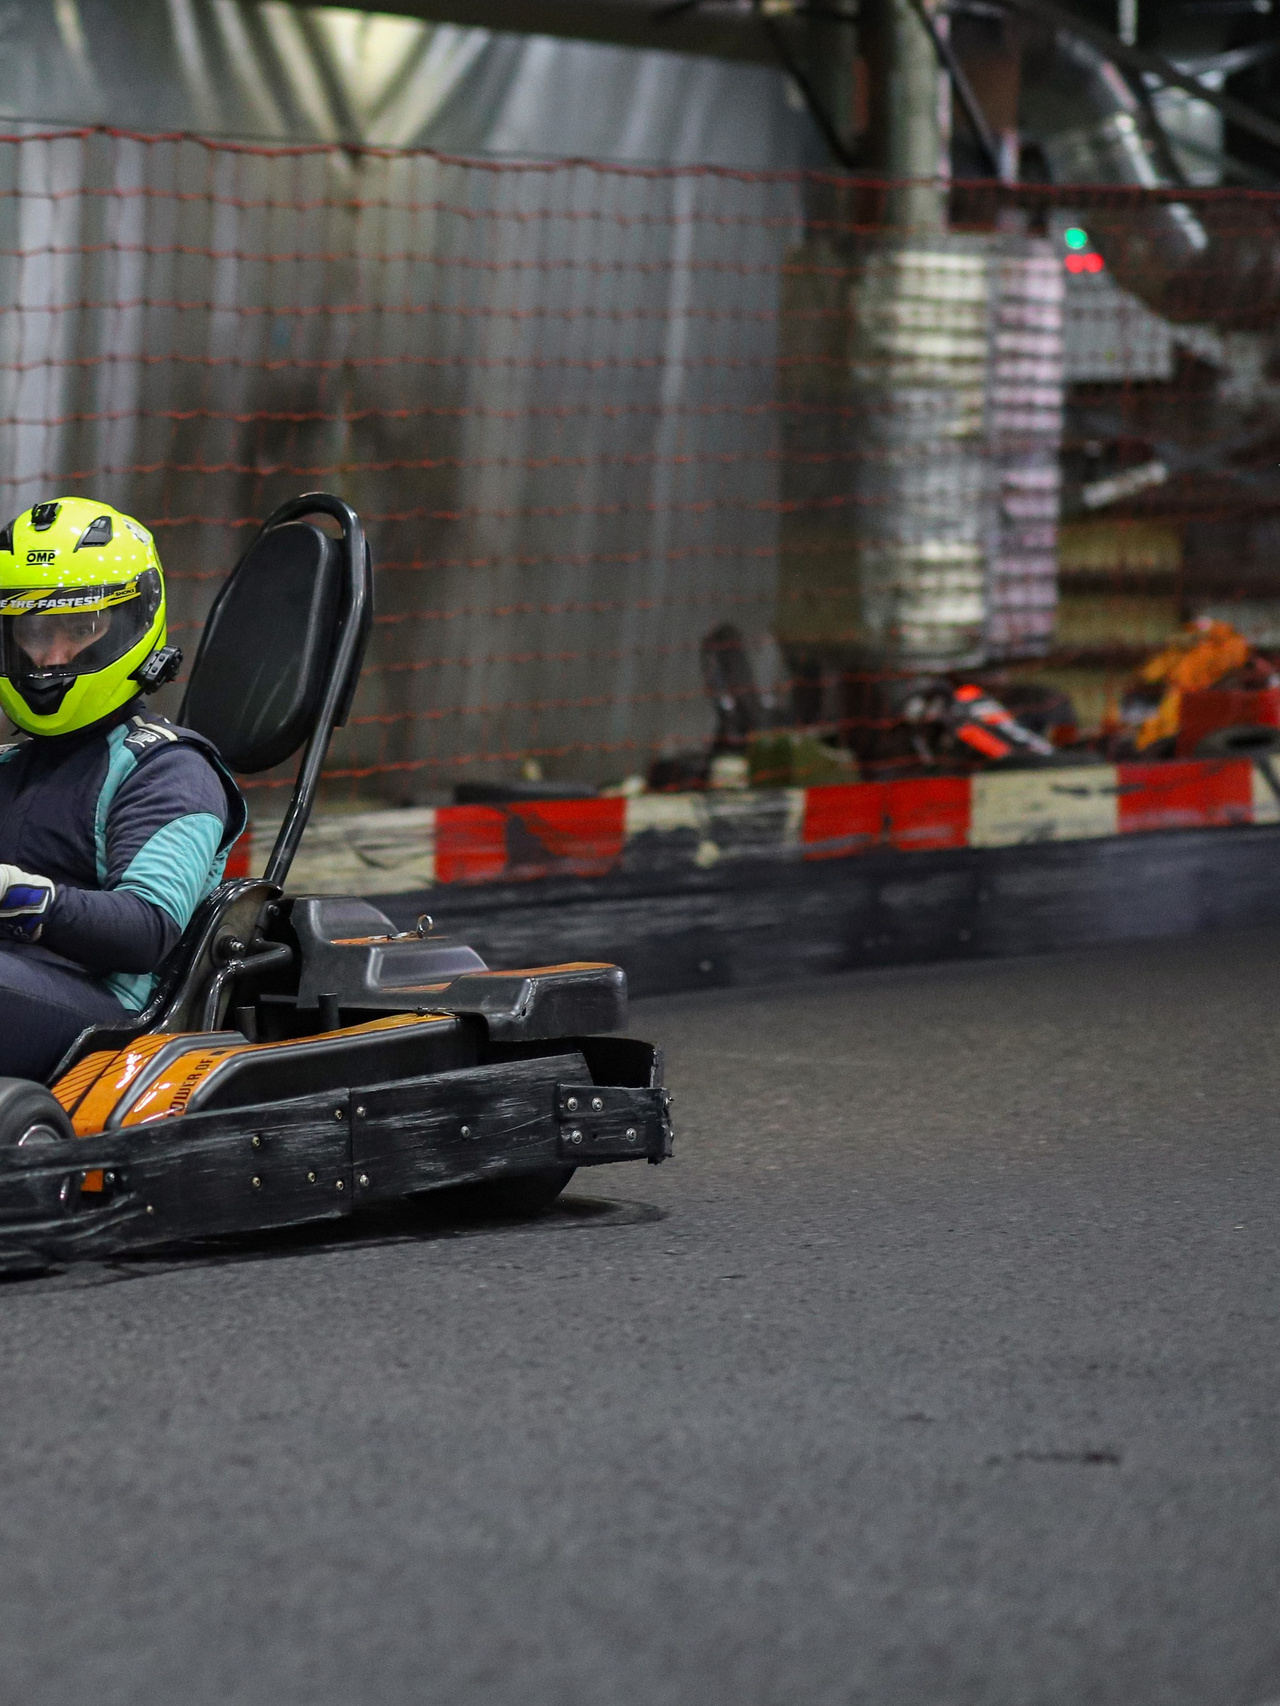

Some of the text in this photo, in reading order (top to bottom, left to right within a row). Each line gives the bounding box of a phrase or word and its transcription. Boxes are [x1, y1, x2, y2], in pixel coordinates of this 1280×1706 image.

[26, 552, 56, 563] OMP
[10, 600, 35, 608] THE
[37, 596, 101, 608] FASTEST
[167, 1058, 214, 1117] OWER OF
